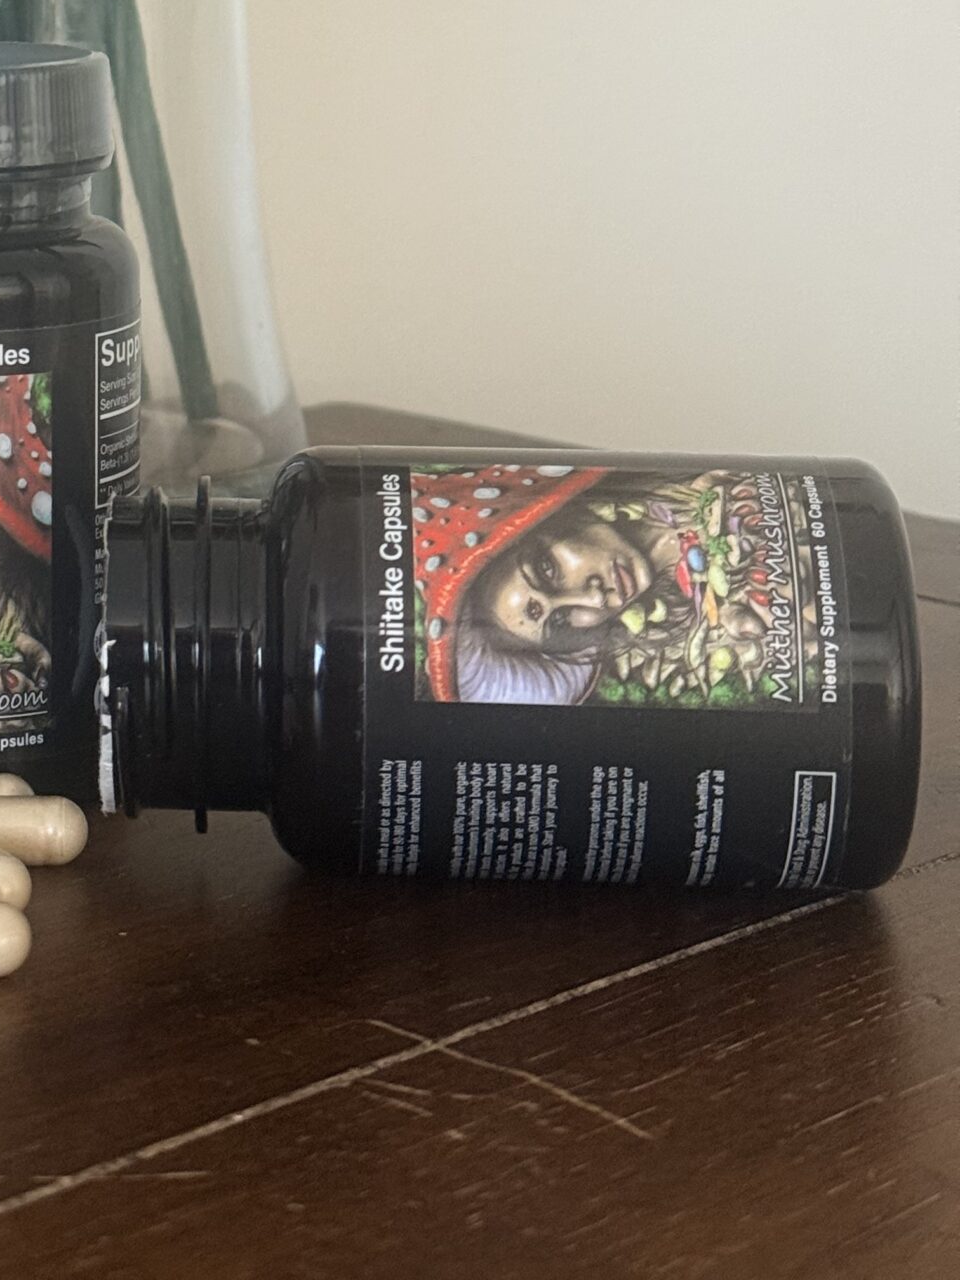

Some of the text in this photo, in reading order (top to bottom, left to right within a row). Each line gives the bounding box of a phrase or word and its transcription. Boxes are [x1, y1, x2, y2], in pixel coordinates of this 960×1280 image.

[757, 472, 787, 584] Mushroom
[376, 474, 408, 673] Shiitake Capsules
[801, 476, 839, 703] Dietary Supplement 60 Capsules
[379, 760, 394, 770] by
[470, 763, 481, 775] for
[484, 763, 497, 787] heart
[515, 764, 527, 776] be
[546, 765, 557, 775] to
[592, 766, 605, 783] age
[609, 766, 618, 778] on
[624, 767, 633, 777] or
[395, 760, 408, 793] optimal
[409, 760, 421, 796] benefits
[454, 762, 468, 795] organic
[500, 763, 512, 794] natural
[515, 782, 527, 791] to
[712, 770, 725, 783] all
[379, 773, 391, 807] directed
[469, 777, 483, 798] body
[528, 764, 542, 815] formula that
[544, 777, 559, 809] journey
[590, 785, 602, 798] the
[608, 781, 618, 795] are
[621, 778, 635, 816] pregnant
[712, 785, 724, 795] of
[394, 794, 406, 805] for
[485, 791, 497, 825] supports
[607, 796, 618, 811] you
[796, 776, 813, 839] Administration.
[380, 808, 391, 817] as
[408, 798, 420, 833] enhanced
[589, 800, 601, 822] under
